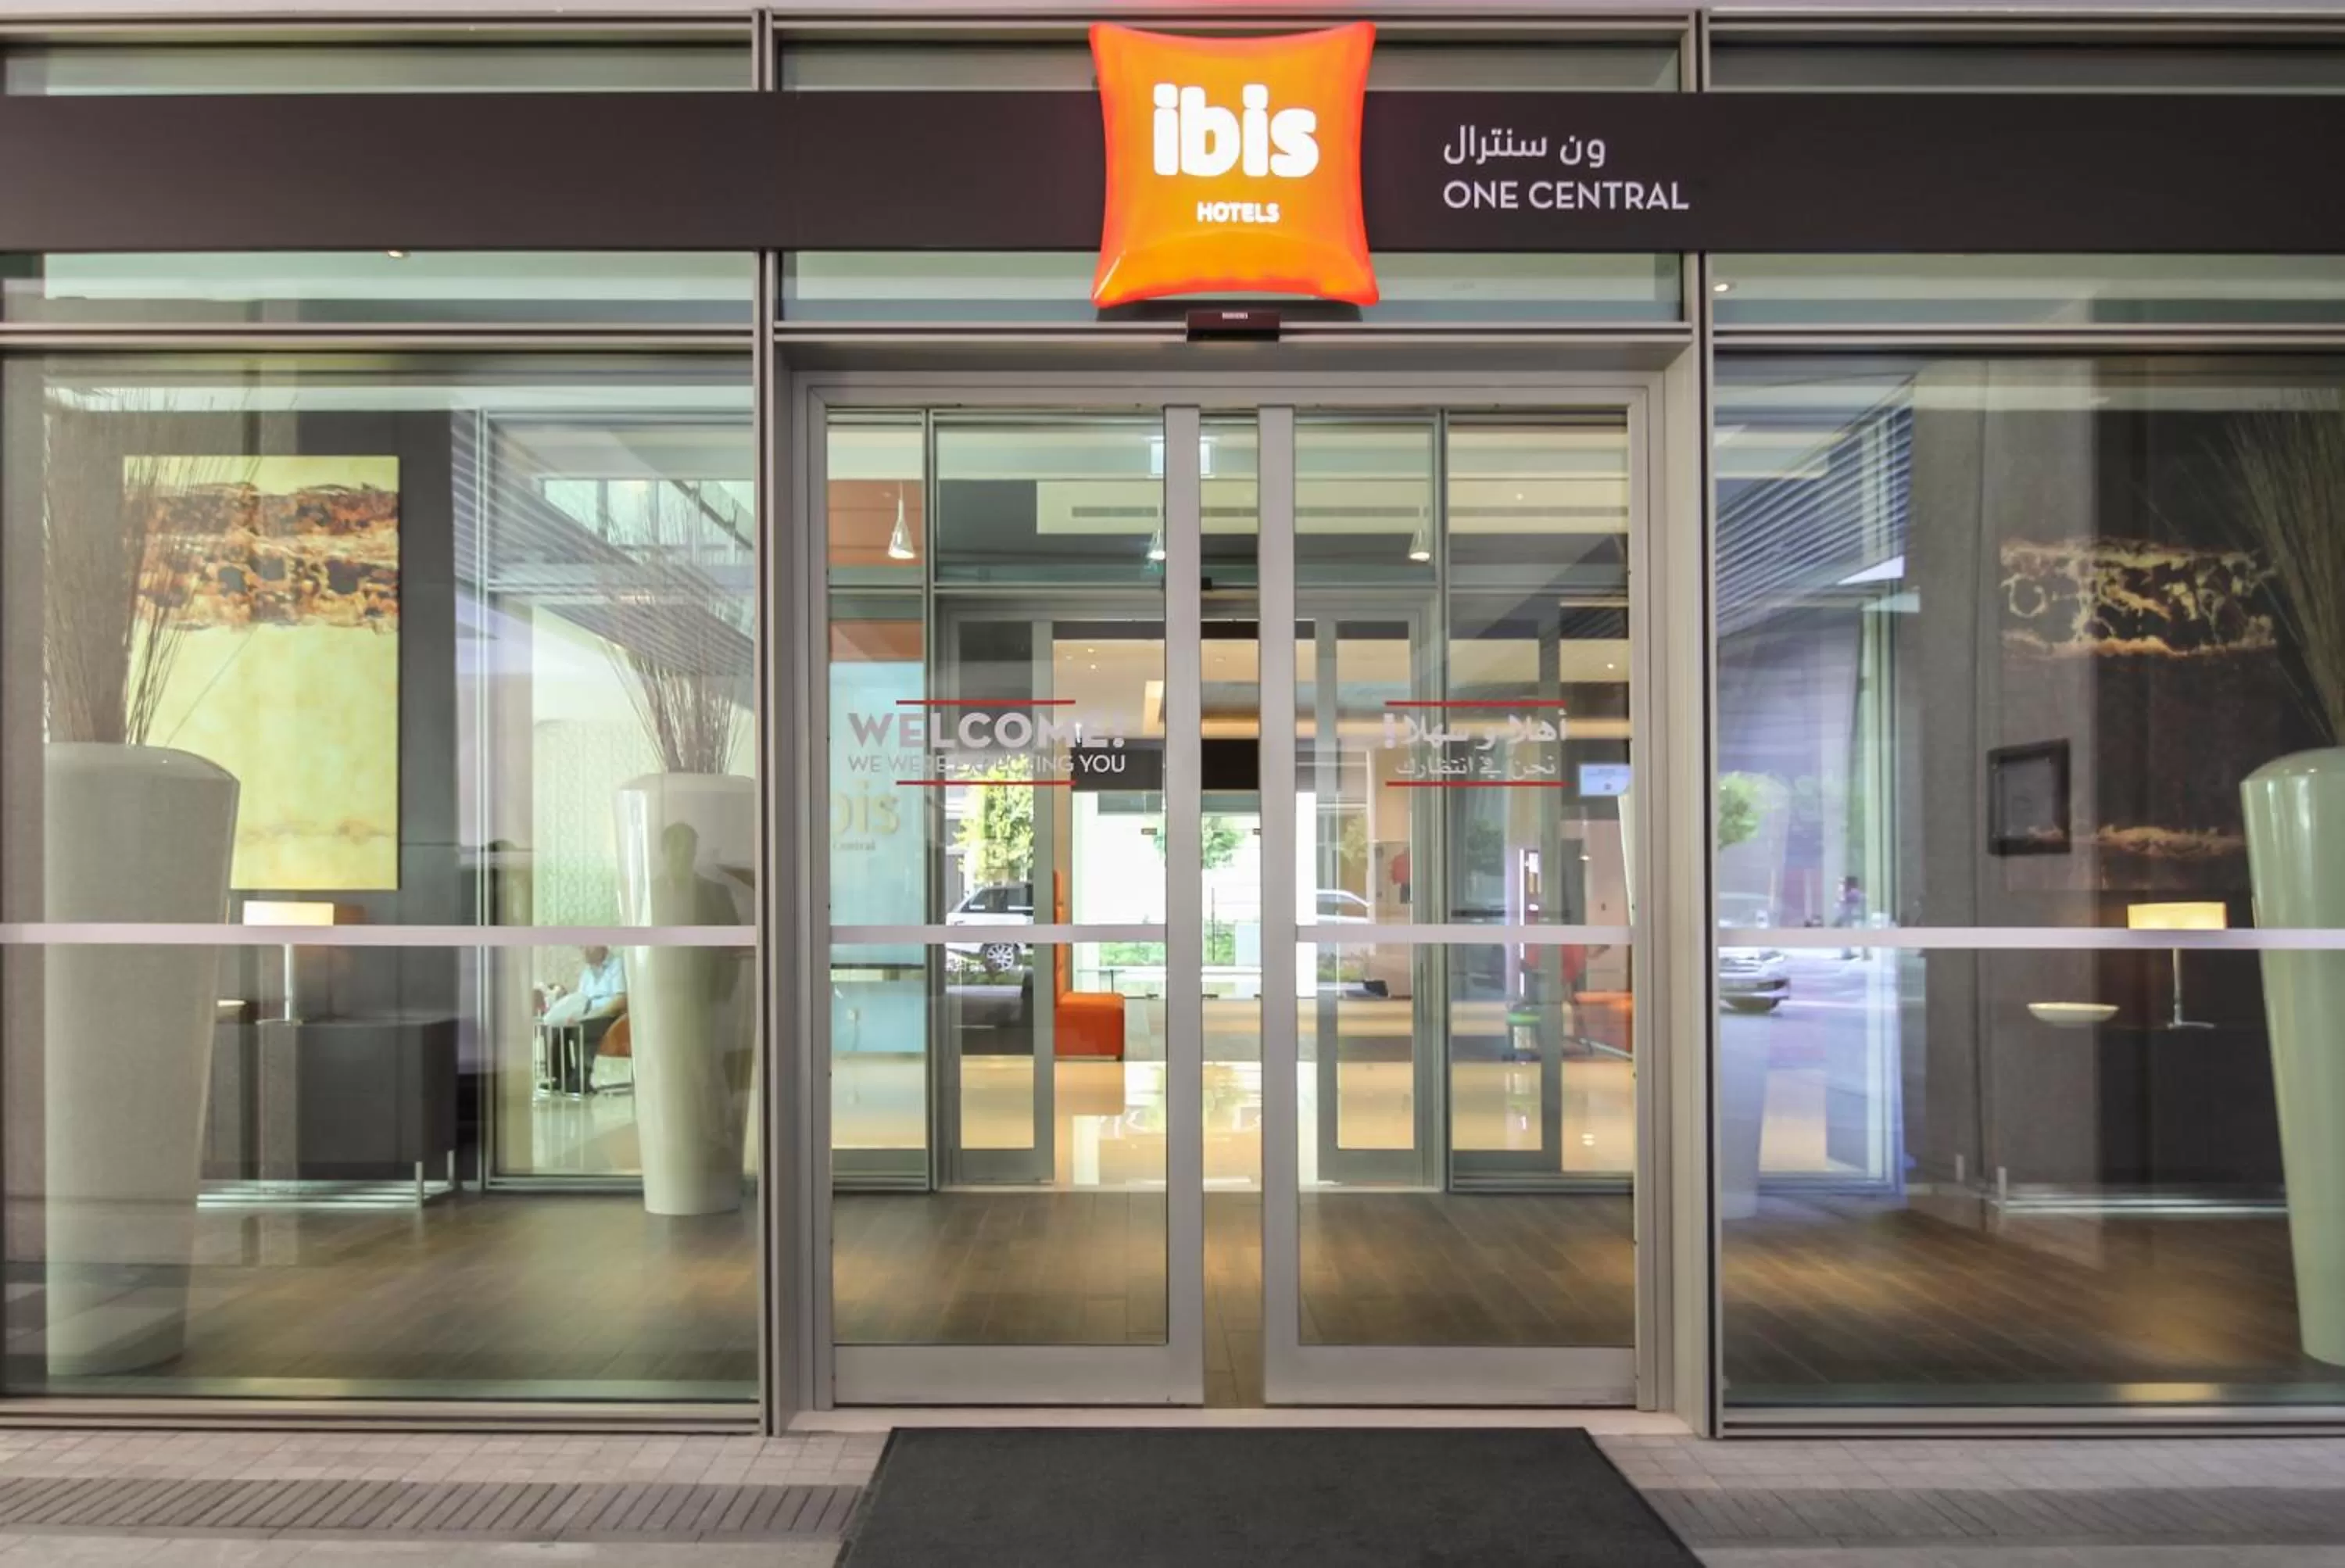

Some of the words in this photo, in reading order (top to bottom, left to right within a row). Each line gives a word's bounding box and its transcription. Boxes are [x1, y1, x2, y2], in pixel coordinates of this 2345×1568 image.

[1153, 82, 1319, 178] ibis
[1443, 124, 1548, 165] سنترال
[1559, 135, 1606, 169] ون
[1197, 201, 1280, 223] HOTELS
[1442, 180, 1519, 209] ONE
[1527, 181, 1689, 210] CENTRAL
[847, 712, 1126, 748] WELCOME!
[848, 755, 882, 772] WE
[1078, 754, 1126, 773] YOU
